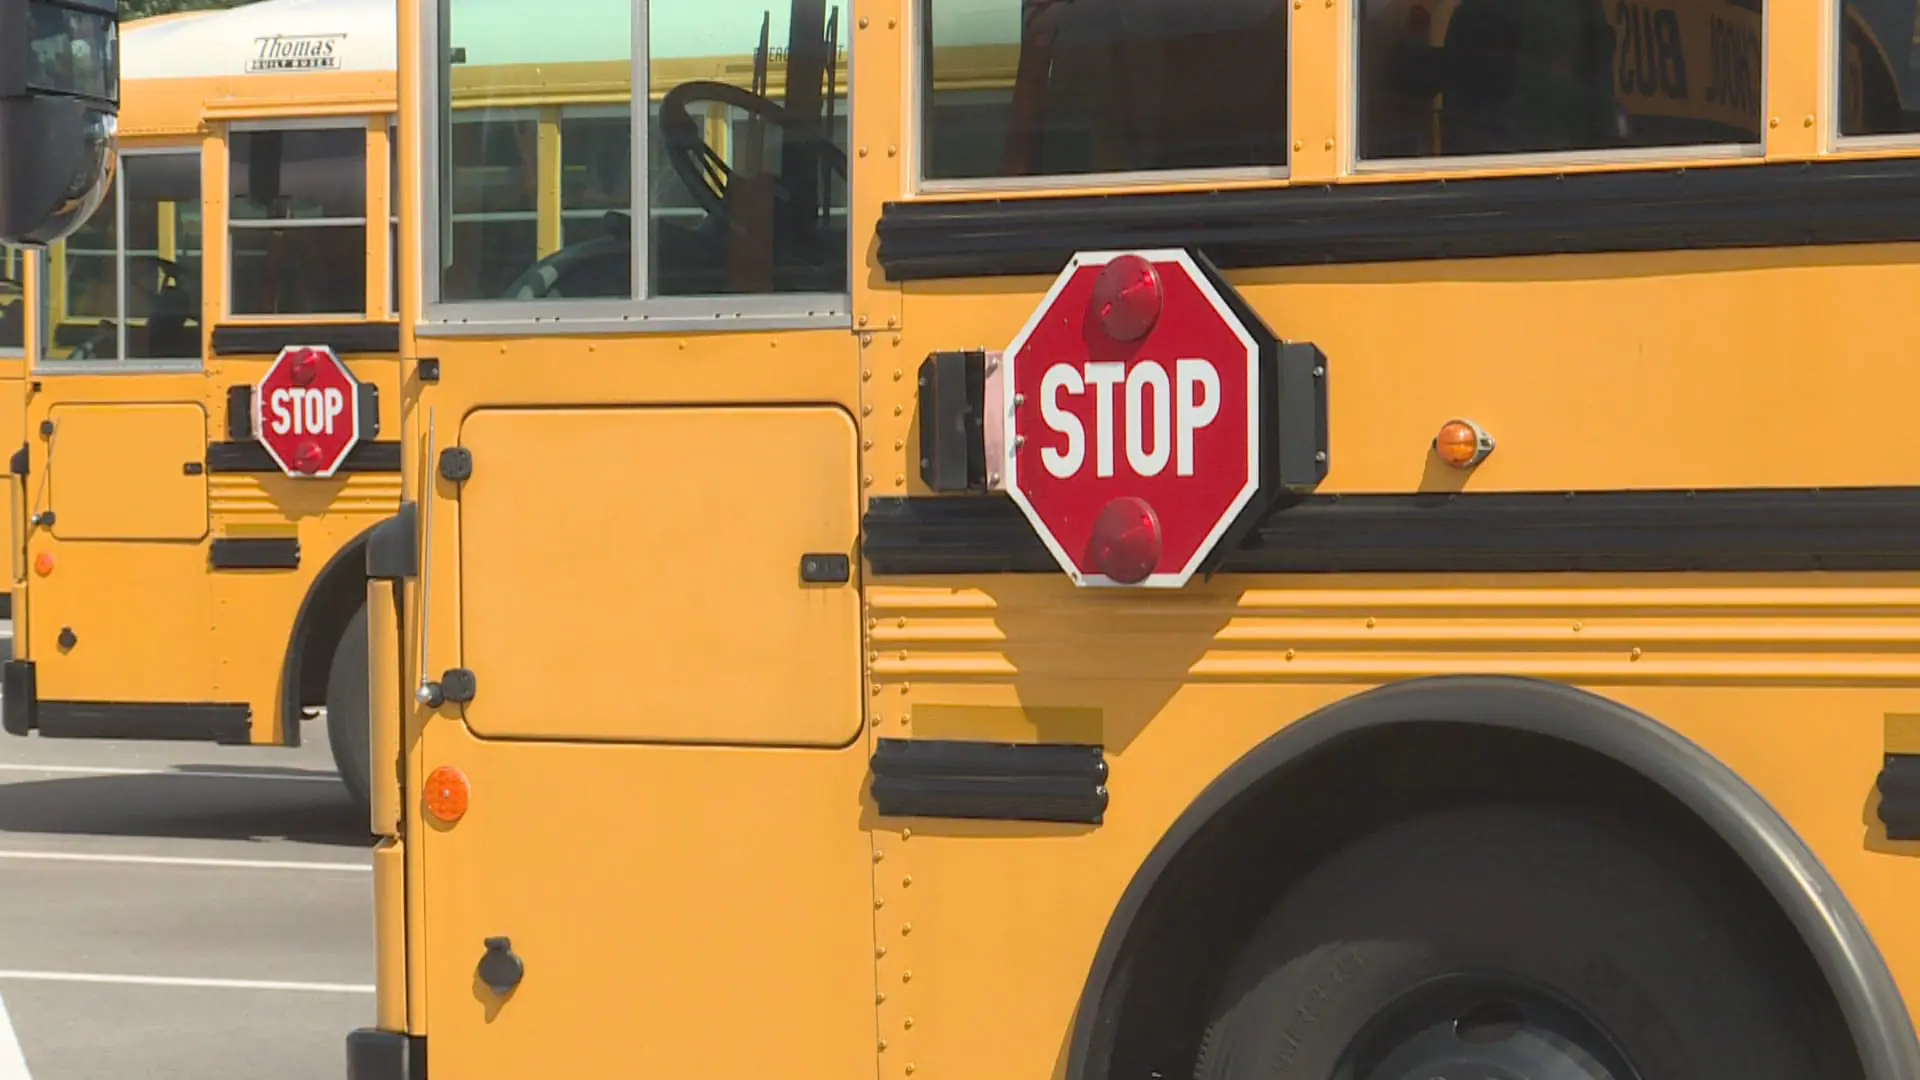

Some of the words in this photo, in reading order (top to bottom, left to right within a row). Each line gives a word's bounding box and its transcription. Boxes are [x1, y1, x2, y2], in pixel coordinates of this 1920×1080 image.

[254, 33, 346, 58] Thomas
[271, 387, 343, 435] STOP
[1040, 358, 1221, 480] STOP
